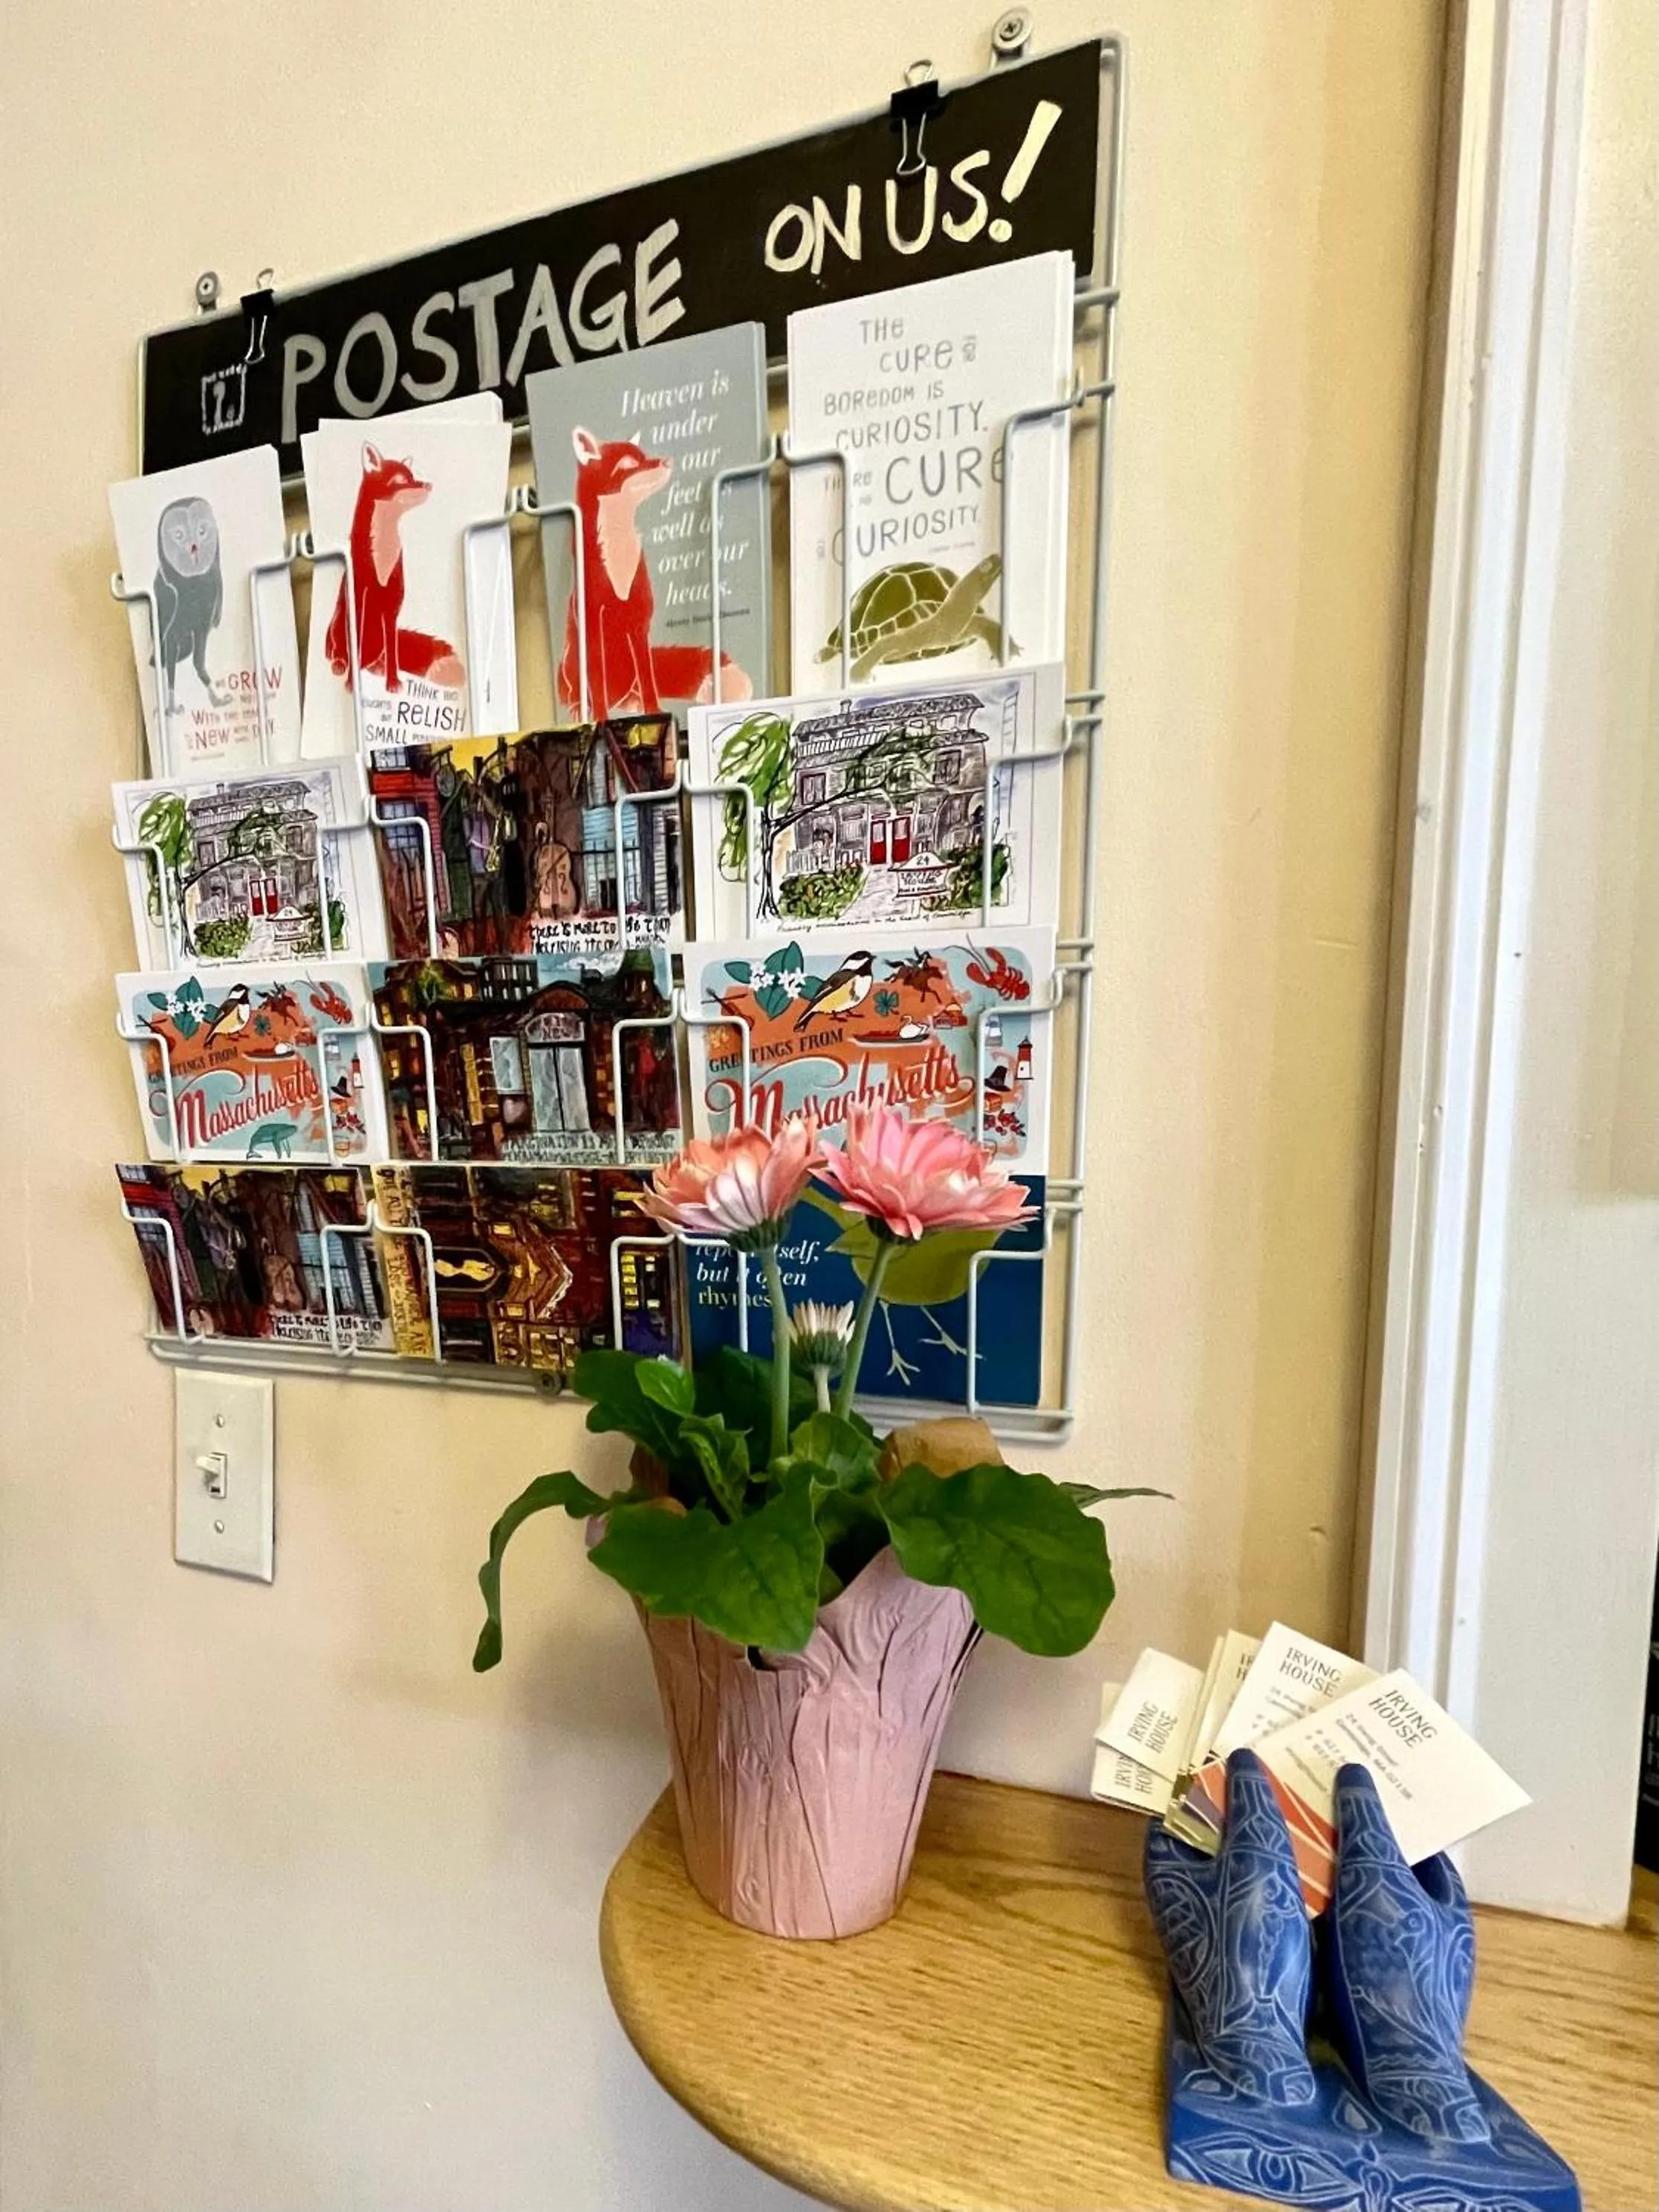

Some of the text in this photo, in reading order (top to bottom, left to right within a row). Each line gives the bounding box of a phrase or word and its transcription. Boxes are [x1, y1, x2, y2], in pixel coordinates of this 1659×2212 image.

[281, 100, 1063, 444] POSTAGE ON US!
[621, 369, 730, 418] Heaven is
[929, 380, 944, 399] IS
[652, 408, 718, 444] under
[837, 400, 988, 450] CURIOSITY.
[682, 448, 721, 472] our
[652, 512, 695, 543] well
[658, 539, 750, 574] over ur
[407, 679, 440, 700] THINK
[366, 724, 408, 745] SMALL
[209, 1046, 238, 1066] FROM
[709, 1029, 843, 1073] GRETINGS FROM
[149, 1061, 323, 1152] Massachusetts
[773, 1239, 820, 1265] self,
[697, 1262, 730, 1282] but
[756, 1267, 807, 1290] oen
[1279, 1661, 1339, 1699] HOUSE
[1286, 1647, 1343, 1684] IRVING
[1126, 1700, 1159, 1743] IRVING
[1144, 1710, 1178, 1754] HOUSE
[1368, 1696, 1423, 1751] HOUSE
[1382, 1688, 1438, 1740] IRVING
[1134, 1763, 1153, 1795] HOU
